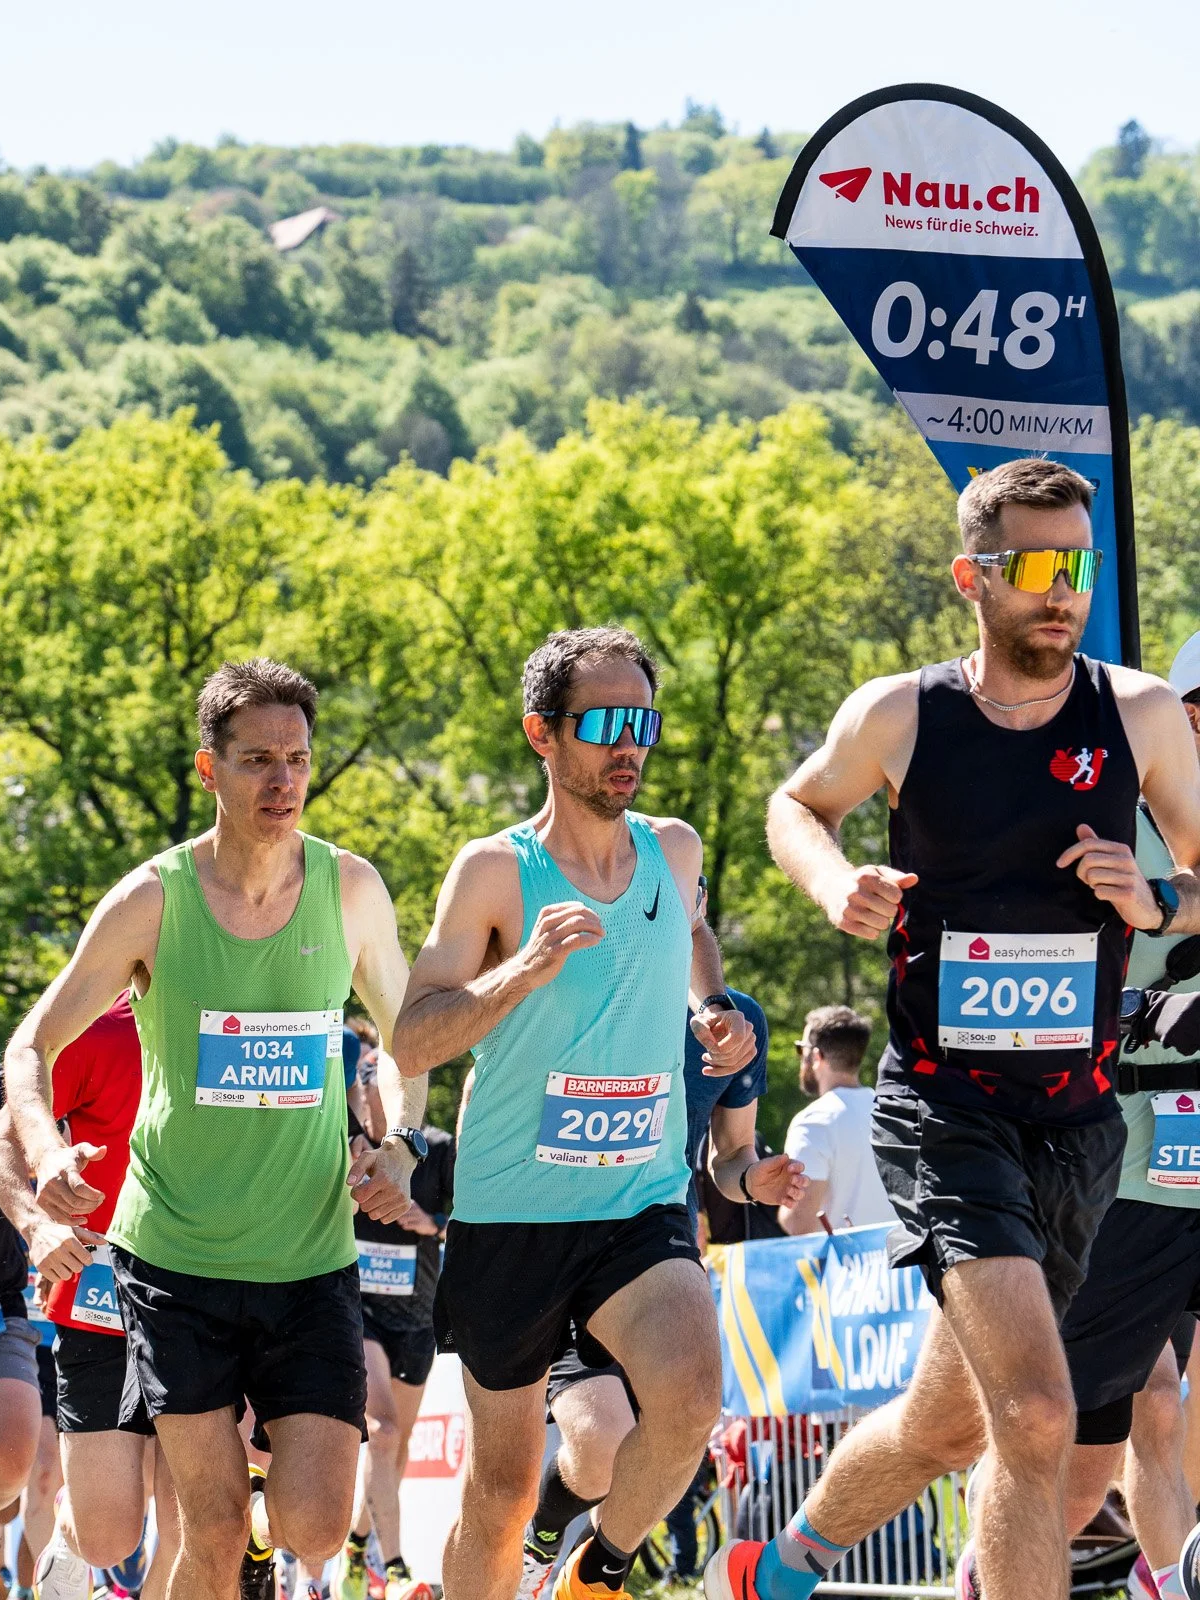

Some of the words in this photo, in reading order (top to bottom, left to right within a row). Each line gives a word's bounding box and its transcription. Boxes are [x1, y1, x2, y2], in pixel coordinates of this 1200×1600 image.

[883, 172, 1040, 213] Nau.ch
[885, 214, 923, 230] News
[927, 217, 948, 232] für
[950, 219, 972, 233] die
[975, 220, 1039, 237] Schweiz.
[871, 281, 1061, 370] 0:48
[1009, 414, 1093, 435] MIN/KM
[994, 947, 1075, 960] easyhomes.ch
[960, 976, 1077, 1017] 2096
[244, 1022, 311, 1034] easyhomes.ch
[241, 1041, 294, 1059] 1034
[219, 1065, 308, 1086] ARMIN
[567, 1079, 646, 1093] BÄRNERBÄR
[558, 1108, 653, 1141] 2029
[550, 1152, 588, 1163] valiant
[85, 1287, 120, 1310] SA
